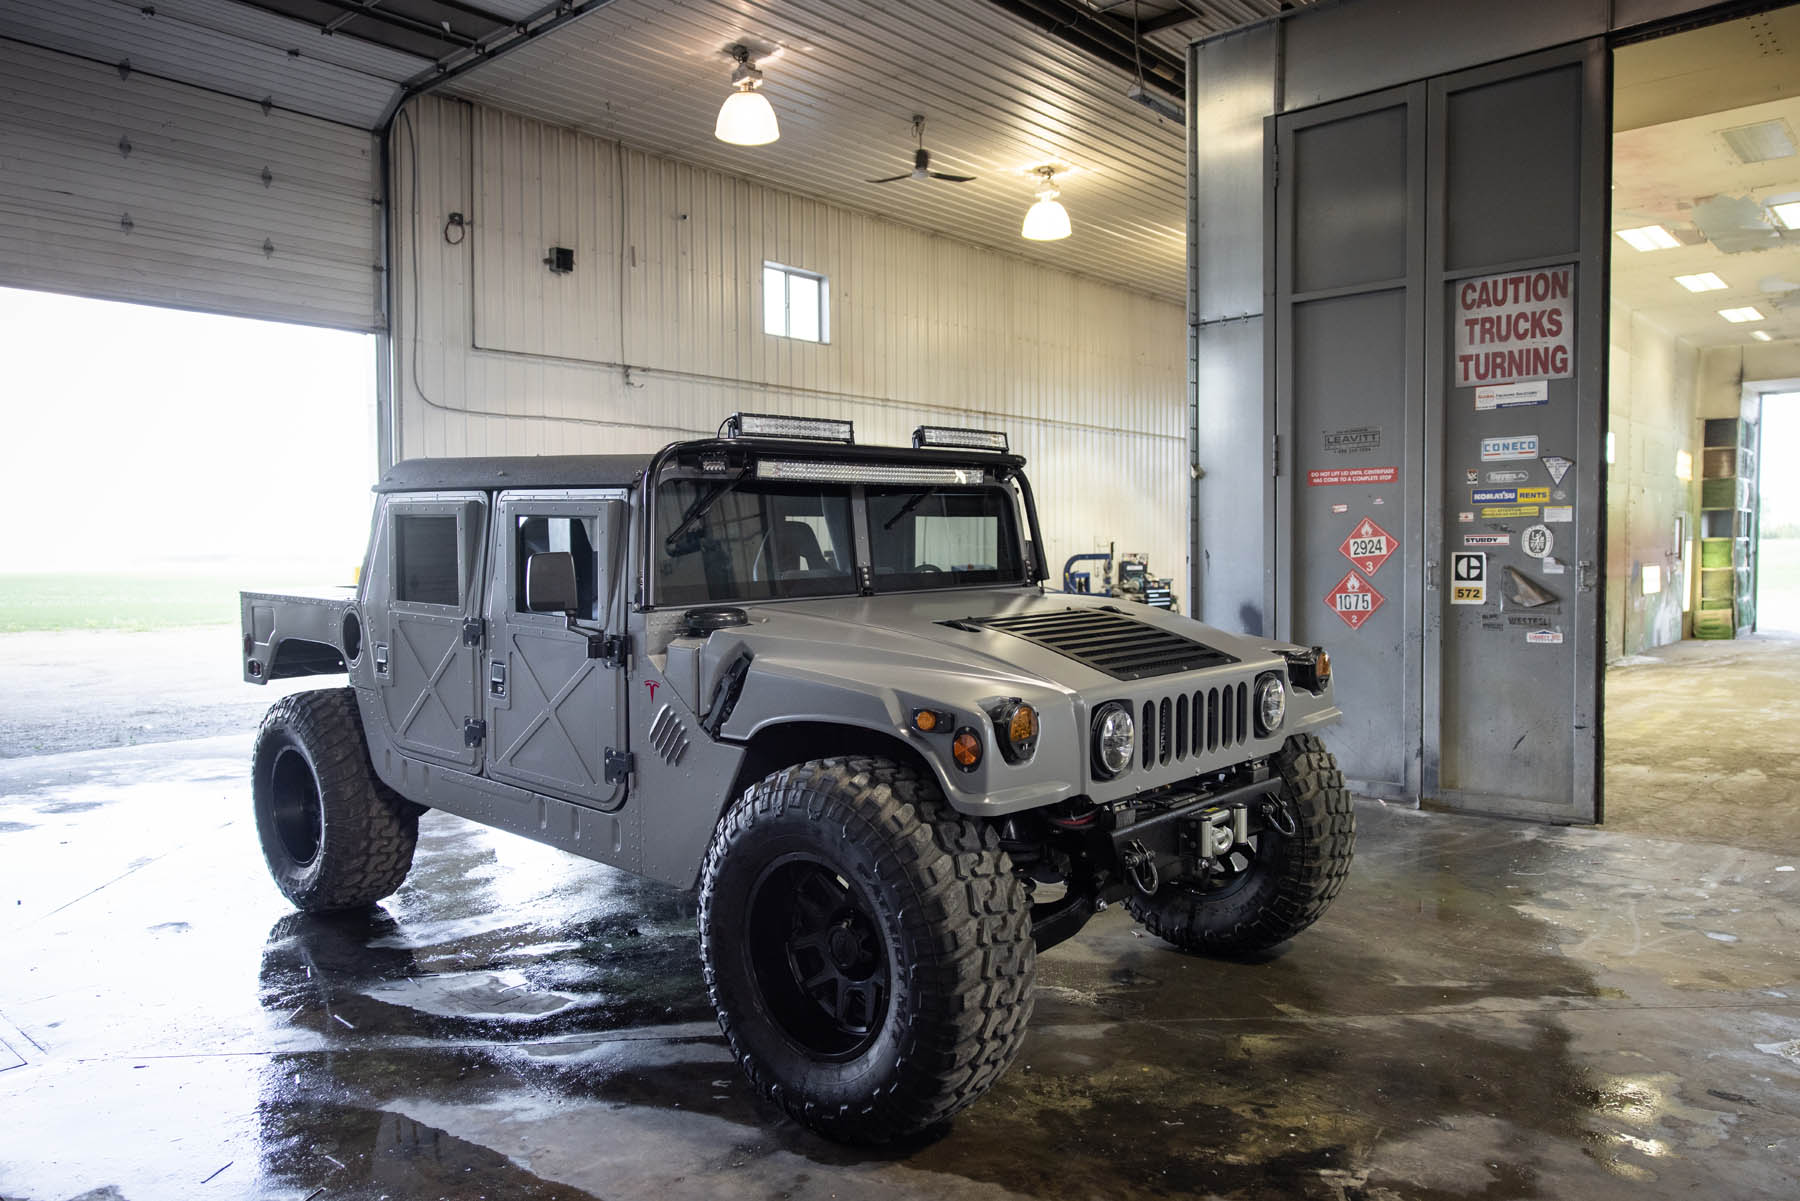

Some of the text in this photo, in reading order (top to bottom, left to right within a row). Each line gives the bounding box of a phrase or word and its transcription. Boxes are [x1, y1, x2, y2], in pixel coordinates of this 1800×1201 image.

[1461, 270, 1569, 311] CAUTION
[1464, 307, 1563, 345] TRUCKS
[1459, 344, 1569, 381] TURNING
[1327, 433, 1376, 444] LEAVITT
[1483, 440, 1537, 453] CONECO
[1474, 490, 1547, 501] KOMATSU RENTS
[1352, 538, 1383, 556] 2924
[1365, 561, 1374, 572] 3
[1457, 589, 1481, 598] 572
[1338, 594, 1369, 610] 1075
[1351, 615, 1358, 623] 2
